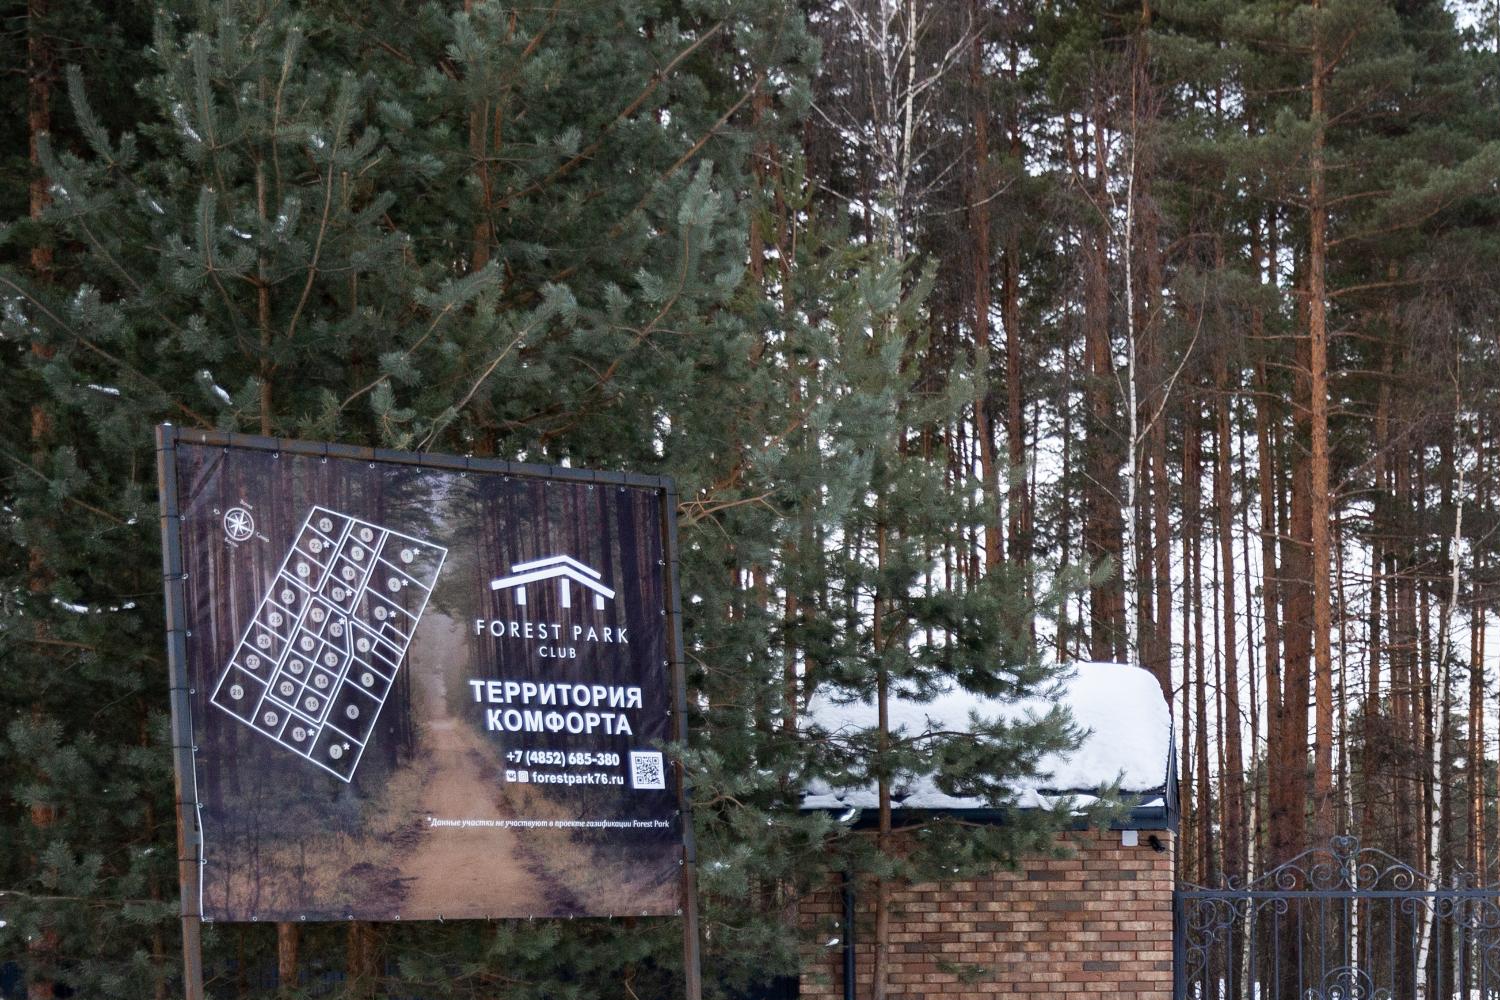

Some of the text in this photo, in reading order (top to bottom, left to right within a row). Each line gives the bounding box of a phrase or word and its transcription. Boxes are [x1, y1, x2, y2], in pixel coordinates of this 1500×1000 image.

[476, 619, 629, 644] FOREST PARK
[539, 646, 577, 659] CLUB
[469, 679, 643, 709] ТЕРРИТОРИЯ
[487, 708, 633, 736] КОМФОРТА
[506, 750, 620, 767] +7 (4852) 685-380
[532, 771, 624, 786] forestpark76.ru
[504, 820, 548, 829] участвуют
[633, 820, 653, 828] Forest
[654, 820, 670, 828] Park
